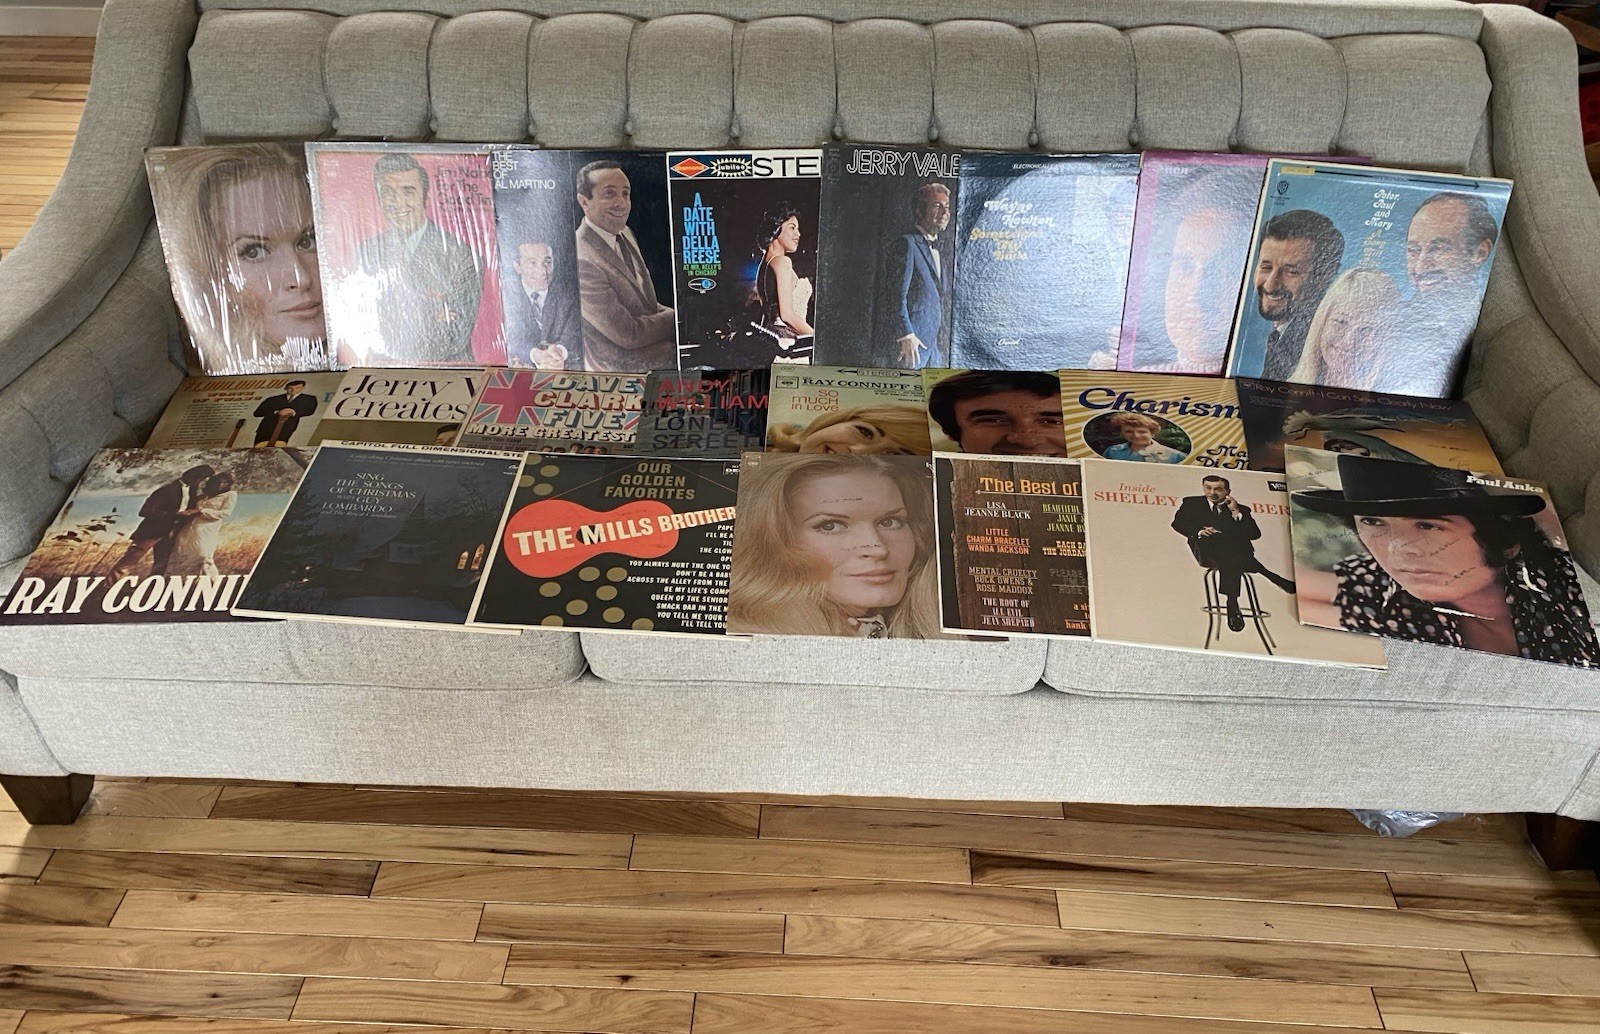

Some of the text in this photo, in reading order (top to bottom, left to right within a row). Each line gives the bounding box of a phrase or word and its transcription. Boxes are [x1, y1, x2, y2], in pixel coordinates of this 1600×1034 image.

[492, 151, 513, 161] THE
[492, 161, 519, 171] BEST
[717, 162, 746, 172] jubilee
[846, 149, 911, 176] JERRY
[911, 151, 961, 179] VALE
[493, 169, 508, 180] OF
[456, 179, 478, 192] The
[495, 179, 556, 189] AL MARTINO
[694, 192, 703, 207] A
[983, 197, 1034, 214] Wayne
[1372, 199, 1396, 210] Paul
[683, 206, 714, 222] DATE
[1373, 209, 1391, 218] and
[684, 221, 716, 236] WITH
[1364, 217, 1393, 231] Mary
[682, 235, 720, 250] DELLA
[683, 249, 721, 264] REESE
[683, 263, 690, 271] AT
[687, 269, 694, 277] IN
[857, 368, 900, 378] STEREO
[342, 375, 442, 396] Jerry
[551, 374, 646, 393] DAVE
[657, 378, 732, 394] ANDY
[802, 379, 836, 387] RAY
[837, 379, 909, 391] CONNIFF
[818, 389, 839, 398] SO
[1255, 384, 1276, 394] Ray
[1326, 391, 1350, 400] Can
[1420, 401, 1452, 411] Now
[533, 390, 643, 411] CLARK
[335, 396, 468, 419] Greates
[542, 408, 630, 431] FIVE
[466, 423, 530, 440] MORE
[531, 427, 638, 444] GREATEST
[652, 432, 757, 449] STREET
[341, 440, 388, 448] CAPITOL
[390, 443, 419, 451] FULL
[421, 445, 502, 458] DIMENSIONAL
[1195, 455, 1219, 468] Di
[636, 462, 672, 475] OUR
[355, 472, 385, 481] SING
[620, 474, 686, 488] GOLDEN
[336, 479, 404, 489] THE SONGS
[979, 477, 1079, 496] The Best of
[1119, 482, 1156, 494] Inside
[1466, 475, 1544, 493] Paul Anka
[329, 486, 417, 498] OF CHRISTMAS
[604, 486, 696, 500] FAVORITES
[355, 496, 384, 504] GUY
[1094, 491, 1178, 507] SHELLEY
[322, 502, 393, 513] LOMBARDO
[986, 501, 1007, 510] LISA
[1042, 503, 1081, 513] BEAUTIFUL
[964, 508, 1031, 520] JEANNE BLACK
[1057, 514, 1077, 524] JANIE
[511, 506, 736, 557] THE MILLS BROTHER
[985, 528, 1009, 538] LITTLE
[1046, 523, 1074, 533] JEANNE
[966, 535, 1030, 547] CHARM BRACELET
[1056, 540, 1076, 549] EACH
[967, 544, 1030, 556] WANDA JACKSON
[1042, 547, 1057, 556] THE
[671, 561, 690, 569] HURT
[676, 569, 696, 577] DON'T
[968, 566, 1038, 579] MENTAL CRUELTY
[627, 576, 655, 584] ACROSS
[974, 575, 1034, 587] BUCK OWENS &
[3, 576, 107, 615] RAY
[976, 584, 1034, 595] ROSE MADDOX
[651, 594, 674, 602] QUEEN
[702, 596, 728, 604] SENIOR
[982, 597, 1031, 608] THE ROOT OF
[656, 602, 681, 610] SMACK
[683, 603, 696, 611] DAB
[991, 607, 1023, 617] ALL EVIL
[982, 616, 1035, 628] JEAN SHEPARD
[1064, 620, 1087, 629] hank
